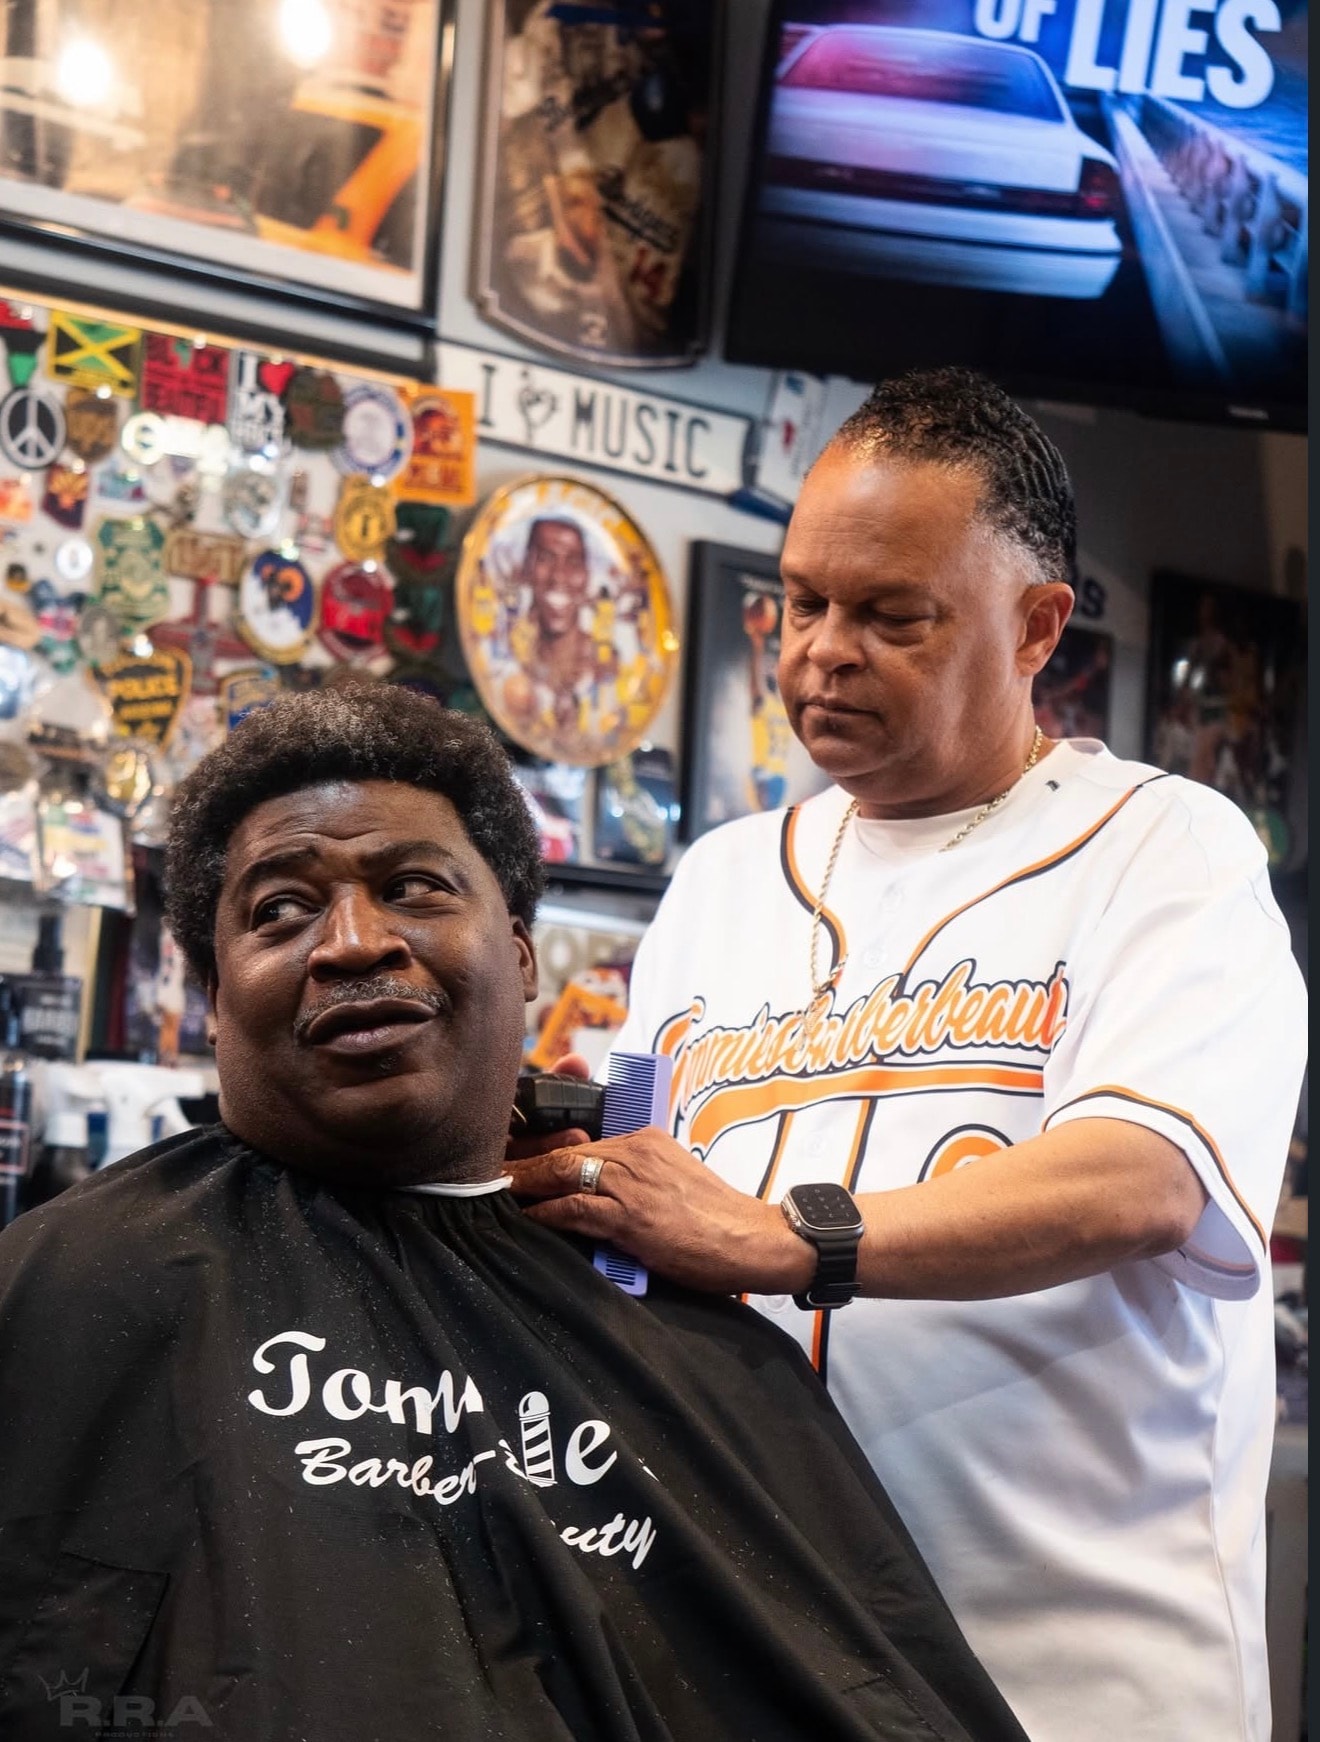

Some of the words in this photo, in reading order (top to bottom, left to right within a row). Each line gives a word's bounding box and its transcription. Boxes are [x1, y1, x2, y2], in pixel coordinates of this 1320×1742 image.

[974, 0, 1057, 43] OF
[1064, 0, 1283, 109] LIES
[479, 363, 498, 428] I
[571, 386, 712, 479] MUSIC
